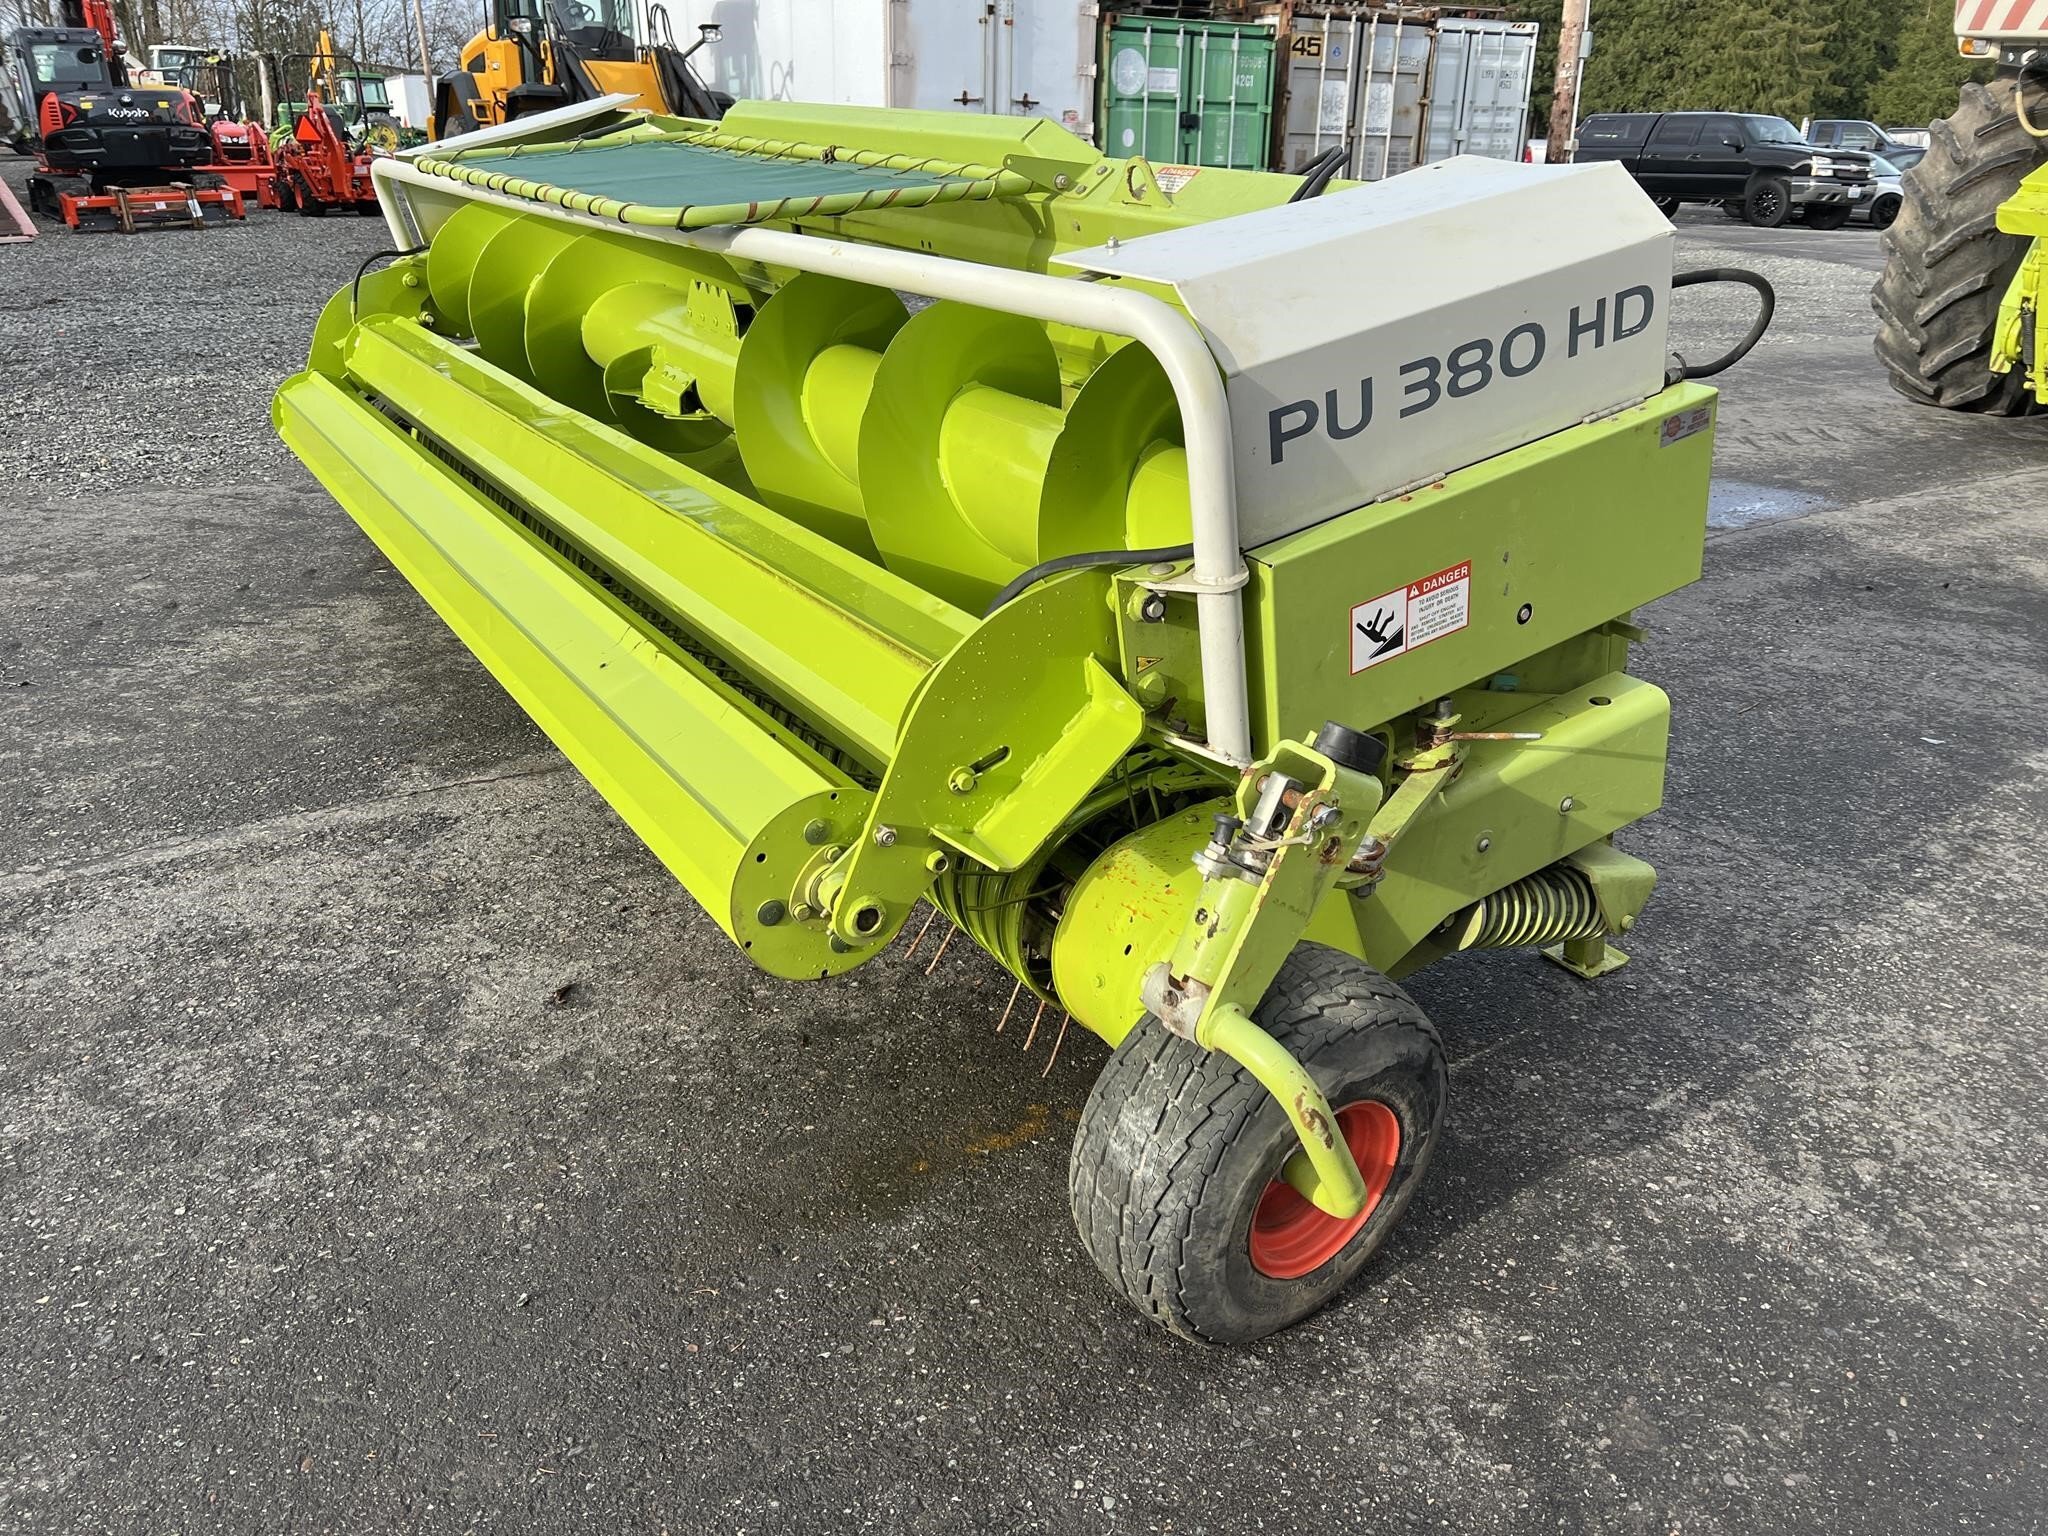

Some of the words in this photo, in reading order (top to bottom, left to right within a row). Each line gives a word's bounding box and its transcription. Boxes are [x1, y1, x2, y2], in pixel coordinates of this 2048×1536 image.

[1292, 36, 1321, 57] 45
[107, 107, 150, 118] Kubota
[1268, 376, 1373, 465] PU
[1399, 322, 1546, 419] 380
[1567, 284, 1655, 358] HD
[1423, 565, 1468, 592] DANGER
